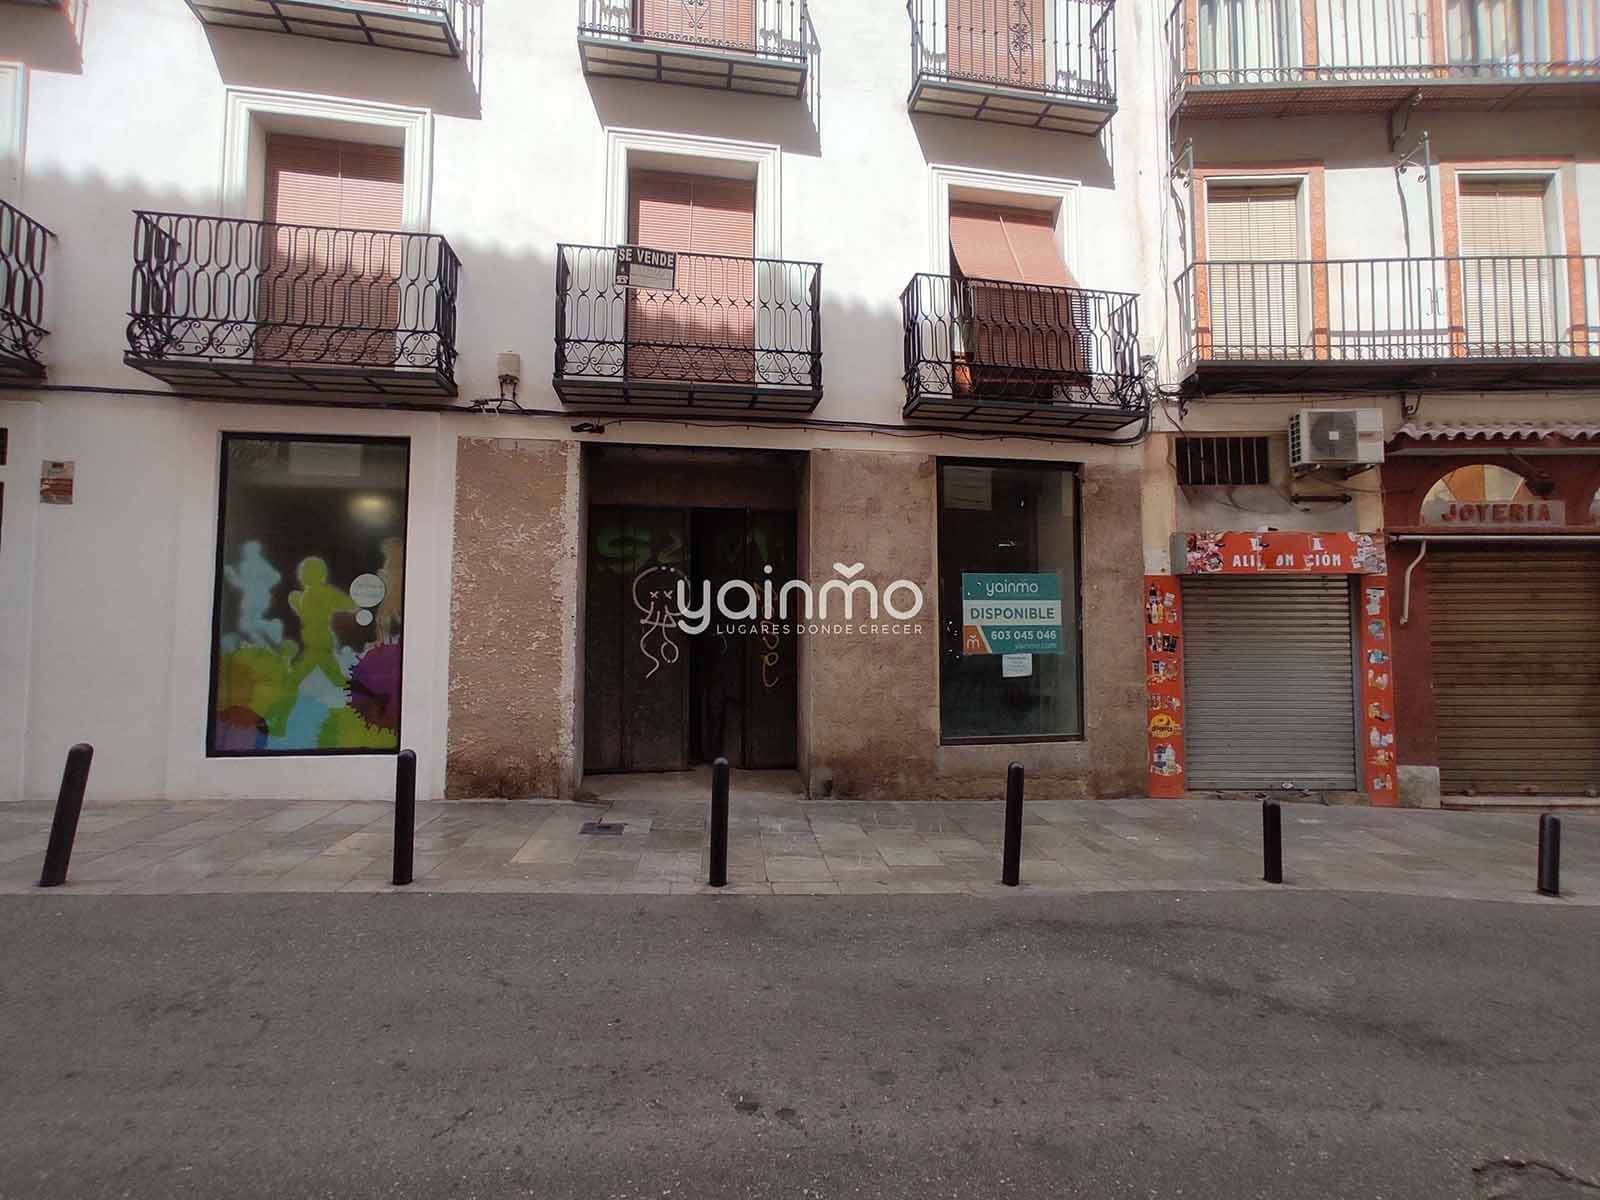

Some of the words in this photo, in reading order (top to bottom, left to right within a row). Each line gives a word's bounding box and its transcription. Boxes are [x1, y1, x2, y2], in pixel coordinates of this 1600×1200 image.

[618, 248, 632, 262] SE
[637, 249, 674, 267] VENDE
[1441, 503, 1550, 522] JOYERIA
[986, 579, 1038, 597] yainmo
[970, 607, 1055, 620] DISPONIBLE
[991, 630, 1011, 641] 603
[1013, 630, 1034, 641] 045
